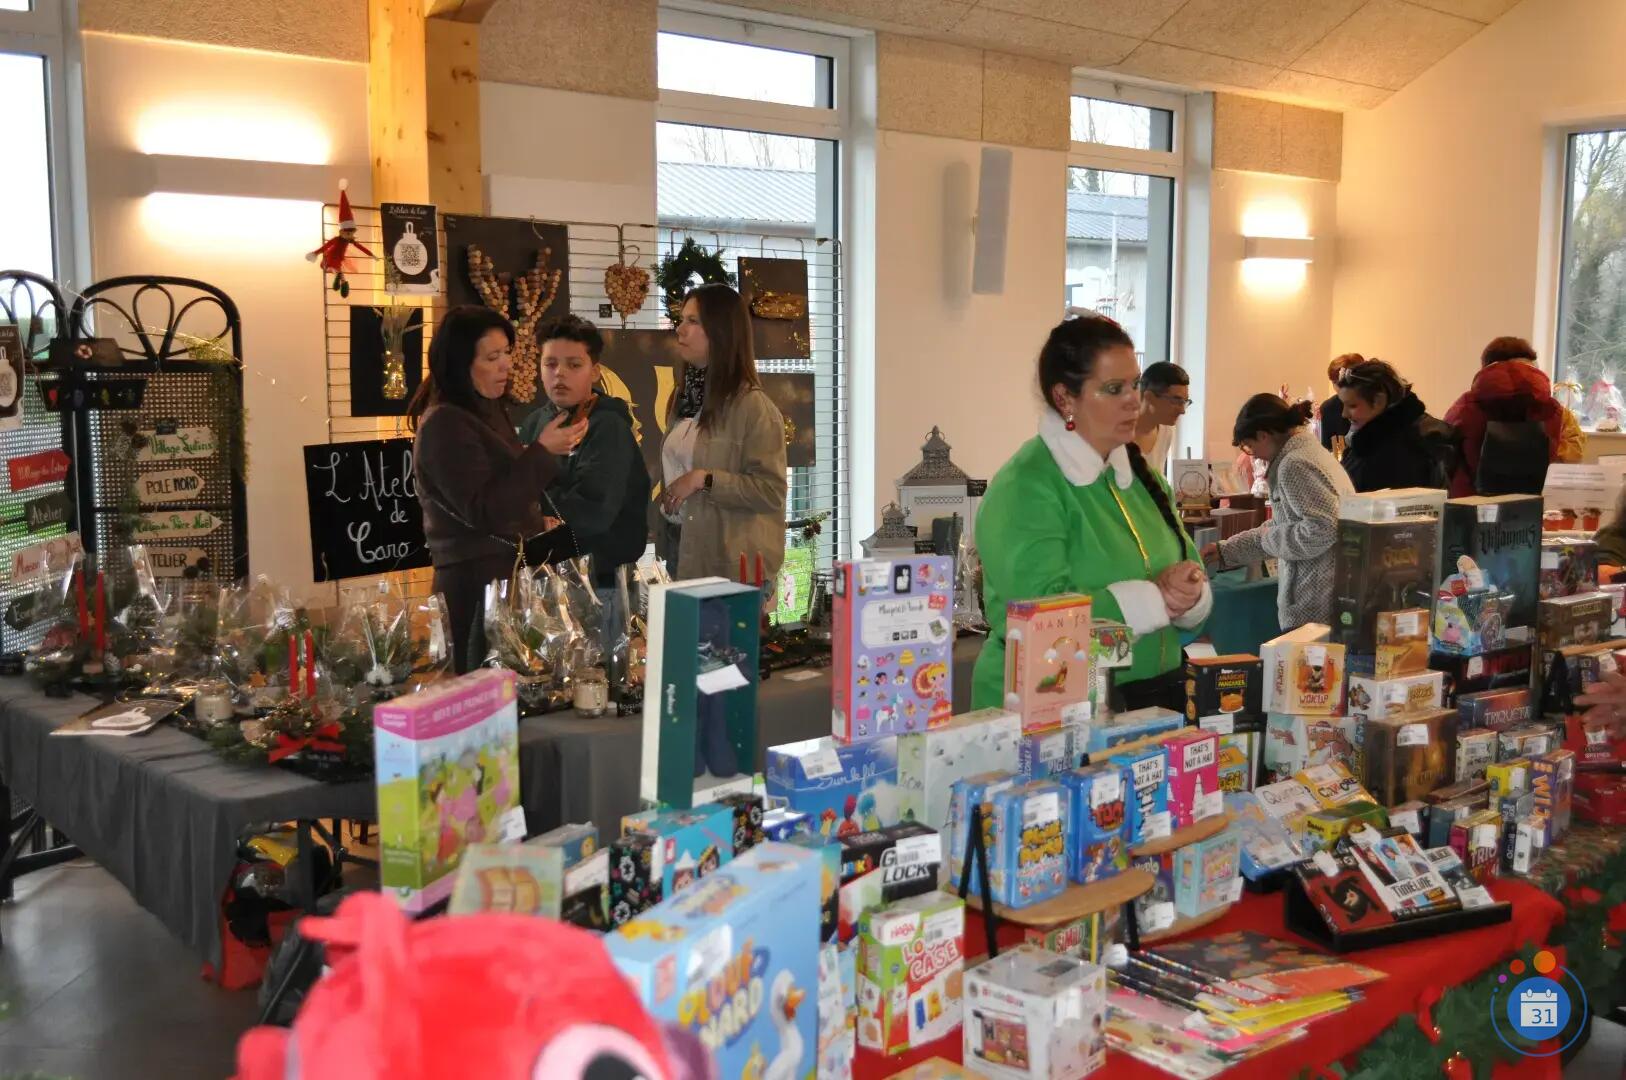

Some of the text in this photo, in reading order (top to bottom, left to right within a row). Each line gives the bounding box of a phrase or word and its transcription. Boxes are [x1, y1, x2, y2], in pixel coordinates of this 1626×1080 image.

[145, 476, 200, 495] POLE NORD
[313, 449, 419, 511] L'Ateli
[390, 499, 409, 523] de
[347, 521, 413, 564] Caro
[1189, 743, 1209, 754] THAT'S
[1138, 759, 1158, 773] THAT'S
[1185, 758, 1196, 769] NOT
[1202, 752, 1213, 764] HAT
[1151, 770, 1163, 781] HAT
[1471, 847, 1497, 866] TRIO
[881, 863, 930, 885] LOCK
[1391, 875, 1434, 896] TIMELINE
[910, 938, 960, 981] CASE
